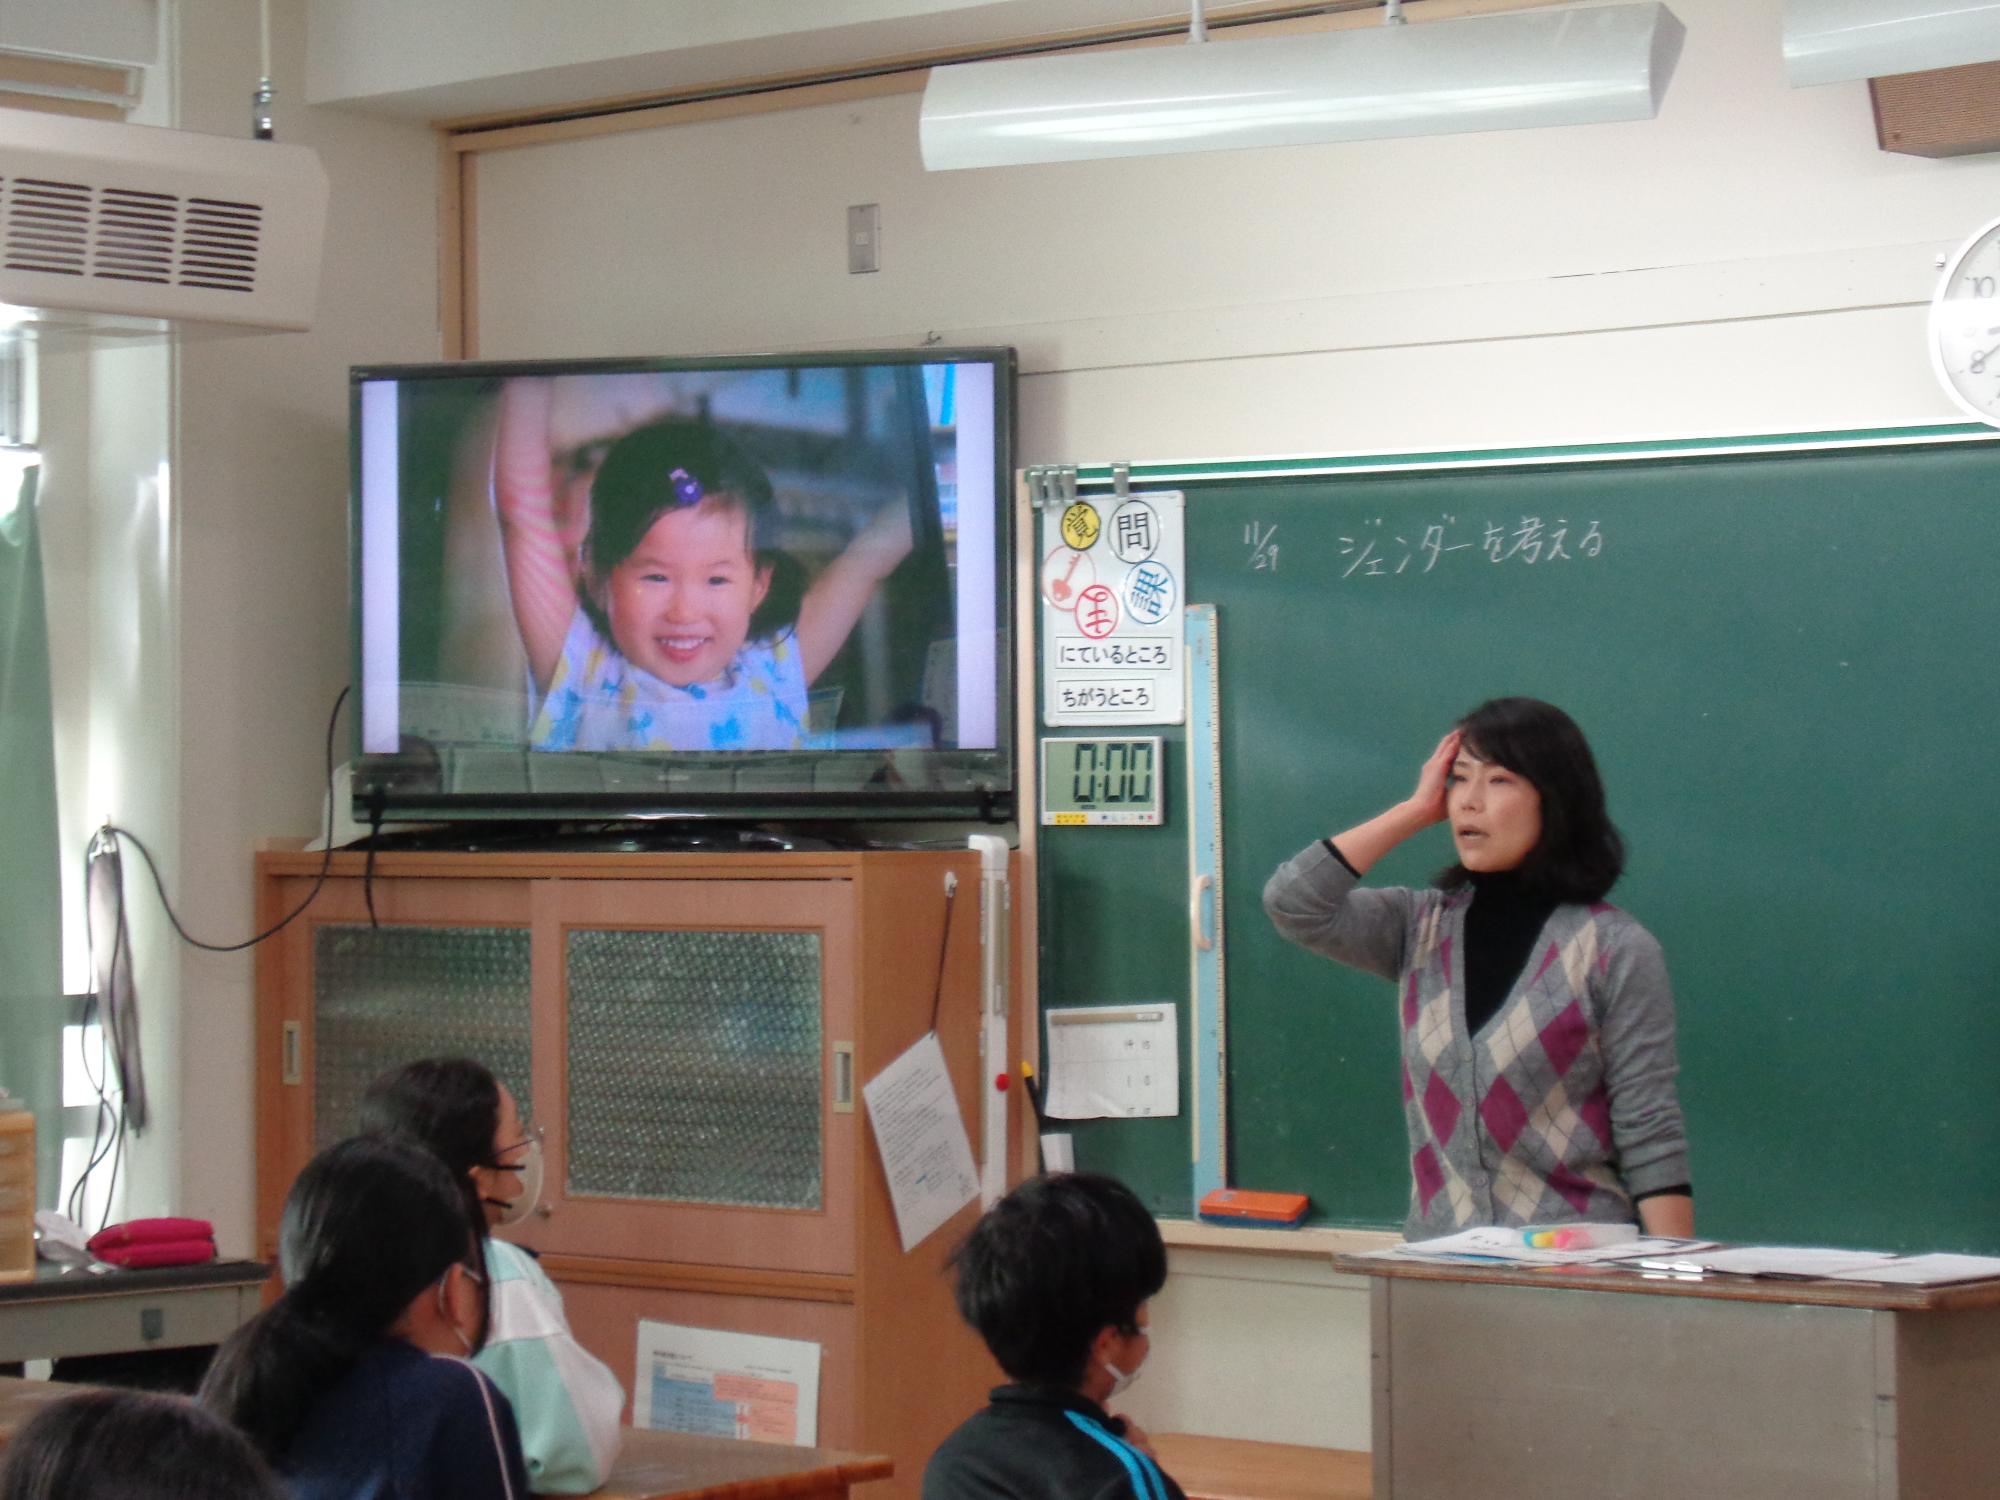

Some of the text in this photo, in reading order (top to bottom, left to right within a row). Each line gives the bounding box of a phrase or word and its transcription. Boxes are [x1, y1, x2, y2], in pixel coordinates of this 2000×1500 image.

[1964, 276, 1996, 299] 10
[1117, 512, 1150, 556] 問
[1338, 513, 1602, 578] ジェンダーを考える
[1060, 645, 1168, 664] にているところ
[1061, 687, 1150, 707] ちがうところ
[1073, 743, 1152, 803] 0:00
